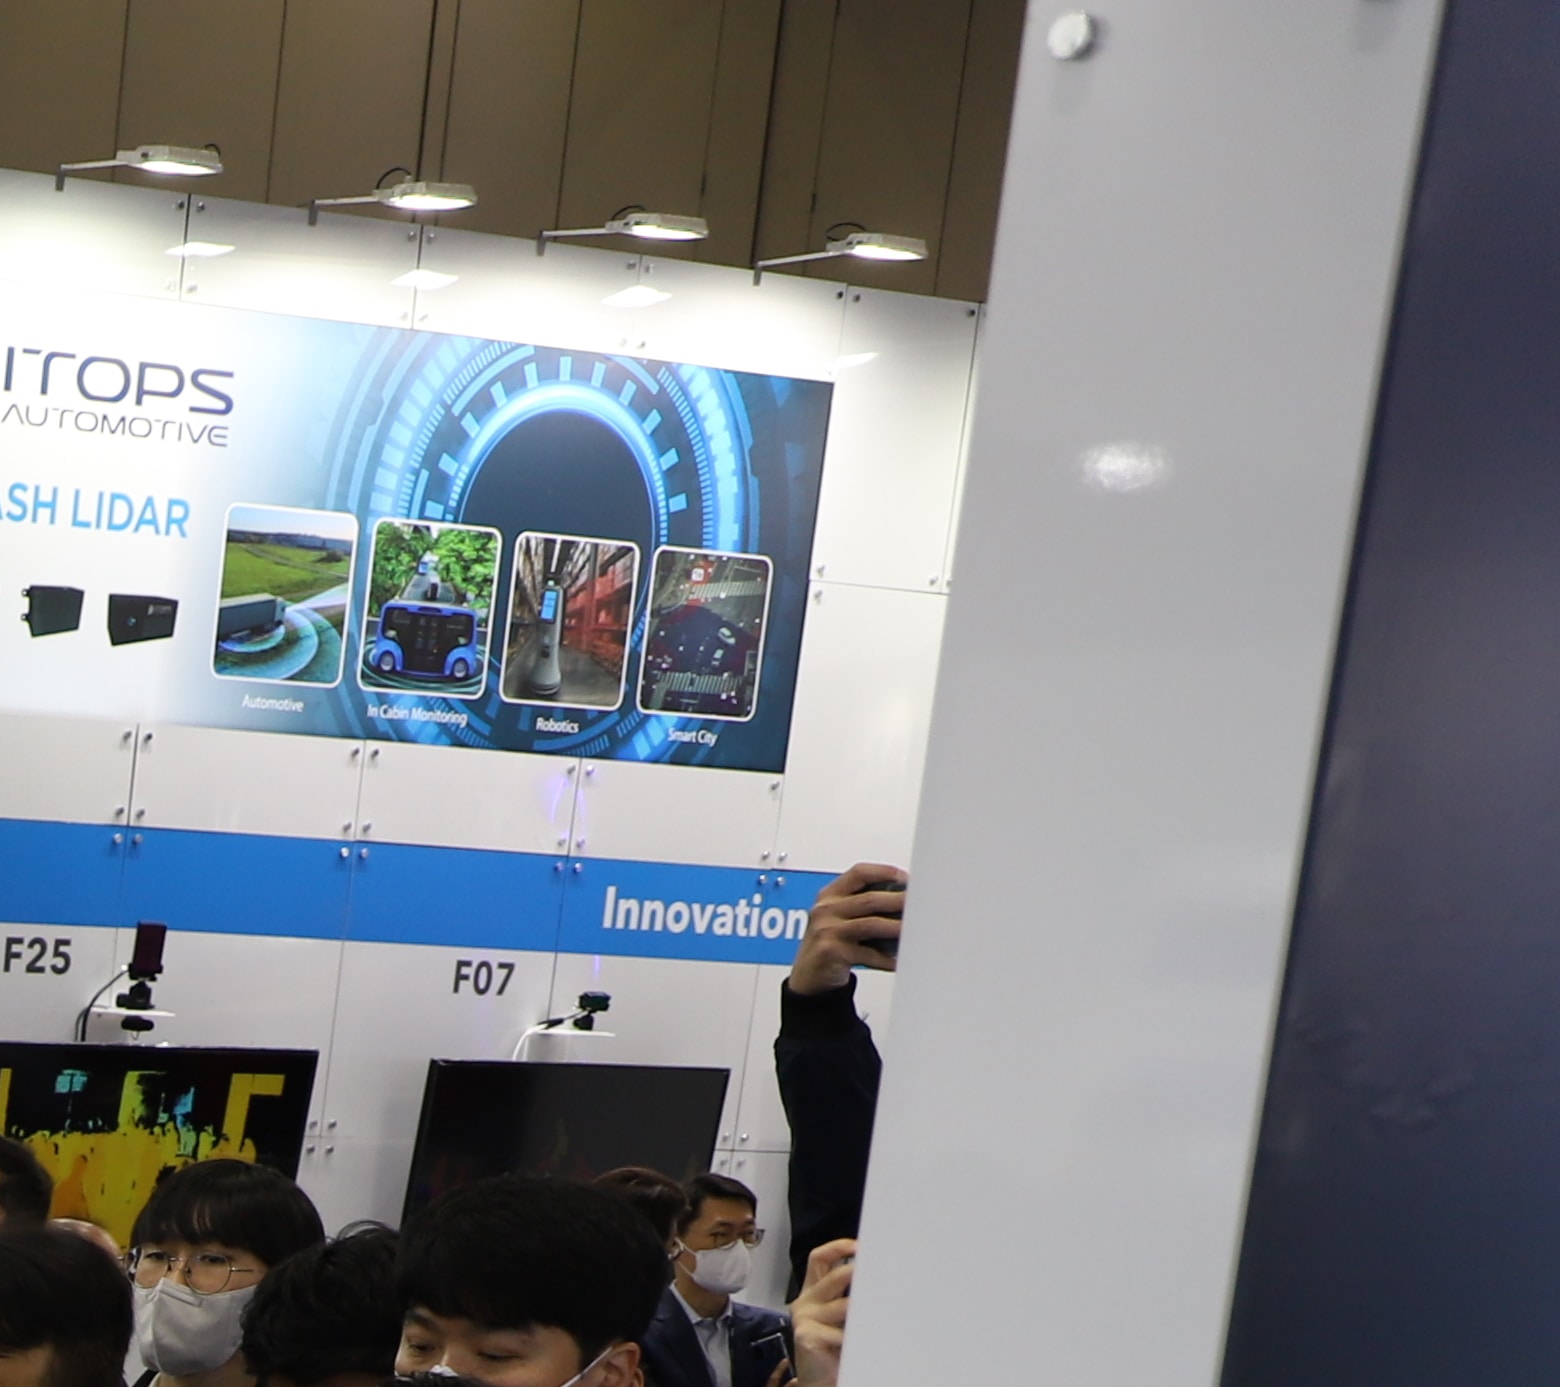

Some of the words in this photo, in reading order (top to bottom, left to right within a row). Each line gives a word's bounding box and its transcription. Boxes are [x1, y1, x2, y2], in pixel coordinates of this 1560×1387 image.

[3, 346, 235, 417] ITOPS
[1, 403, 229, 447] AUTOMOTIVE
[71, 488, 191, 538] LIDAR
[241, 694, 305, 713] Automotive
[367, 704, 378, 716] In
[380, 704, 409, 720] Cabin
[412, 707, 468, 729] Monitoring
[535, 716, 580, 734] Robotics
[667, 727, 695, 744] Smart
[697, 729, 719, 749] City
[603, 885, 808, 941] Innovation
[2, 937, 73, 975] F25
[452, 959, 517, 997] F07
